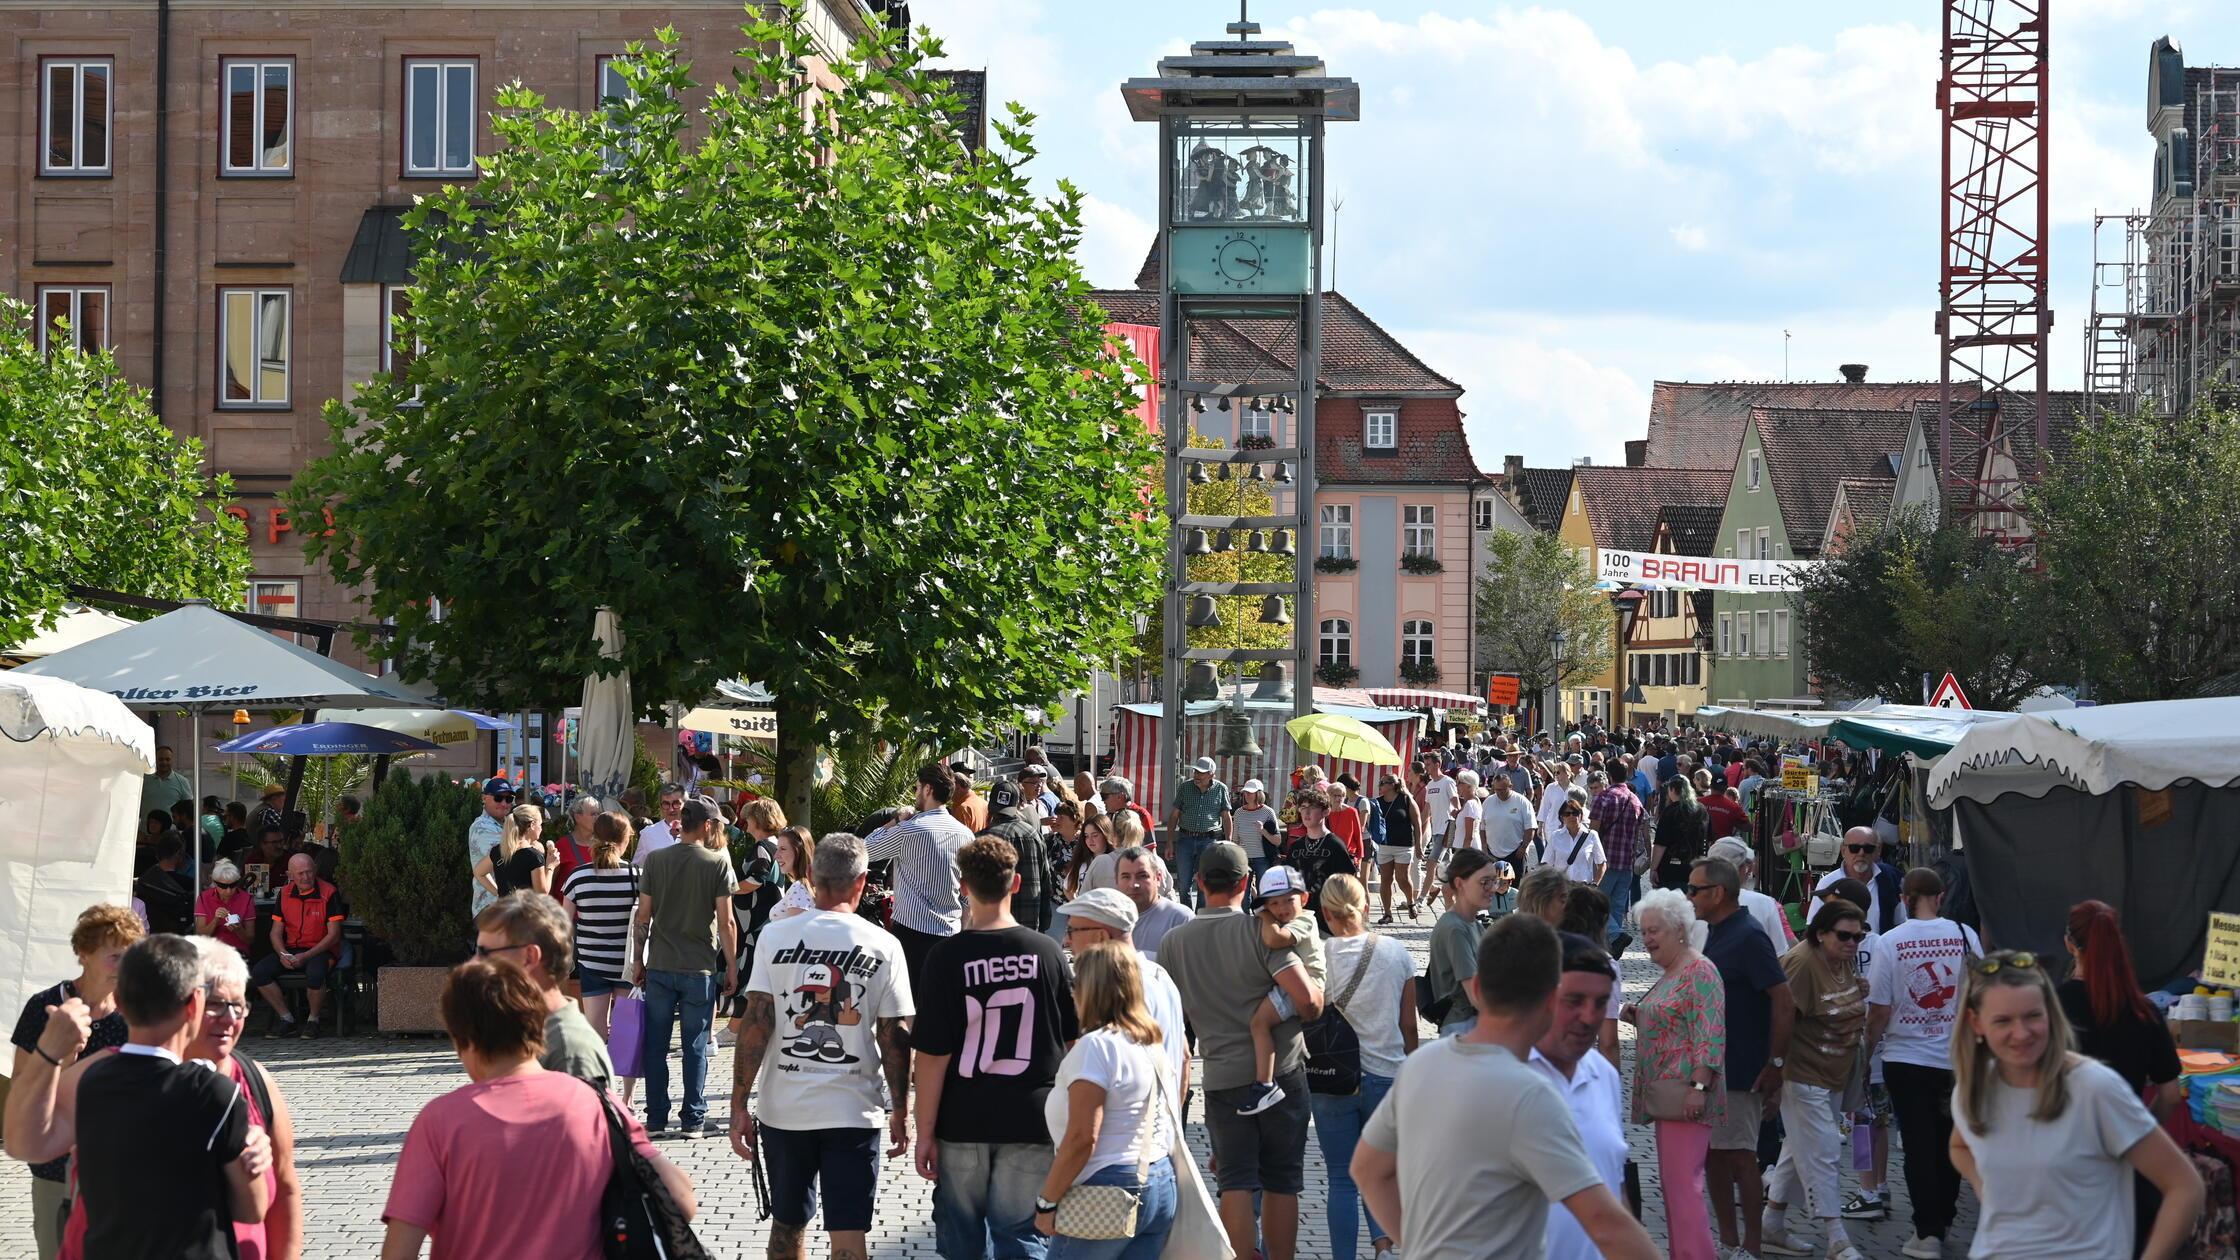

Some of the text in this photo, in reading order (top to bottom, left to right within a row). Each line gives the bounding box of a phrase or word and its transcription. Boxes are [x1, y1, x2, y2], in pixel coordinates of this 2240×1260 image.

[1604, 553, 1630, 567] 100
[1602, 567, 1629, 578] Jahre
[1642, 558, 1740, 585] BRAUN
[184, 685, 258, 698] Bier
[1896, 941, 1918, 952] SLICE
[1918, 939, 1941, 949] SLICE
[964, 954, 1038, 987] MESSI
[958, 986, 1036, 1078] 10
